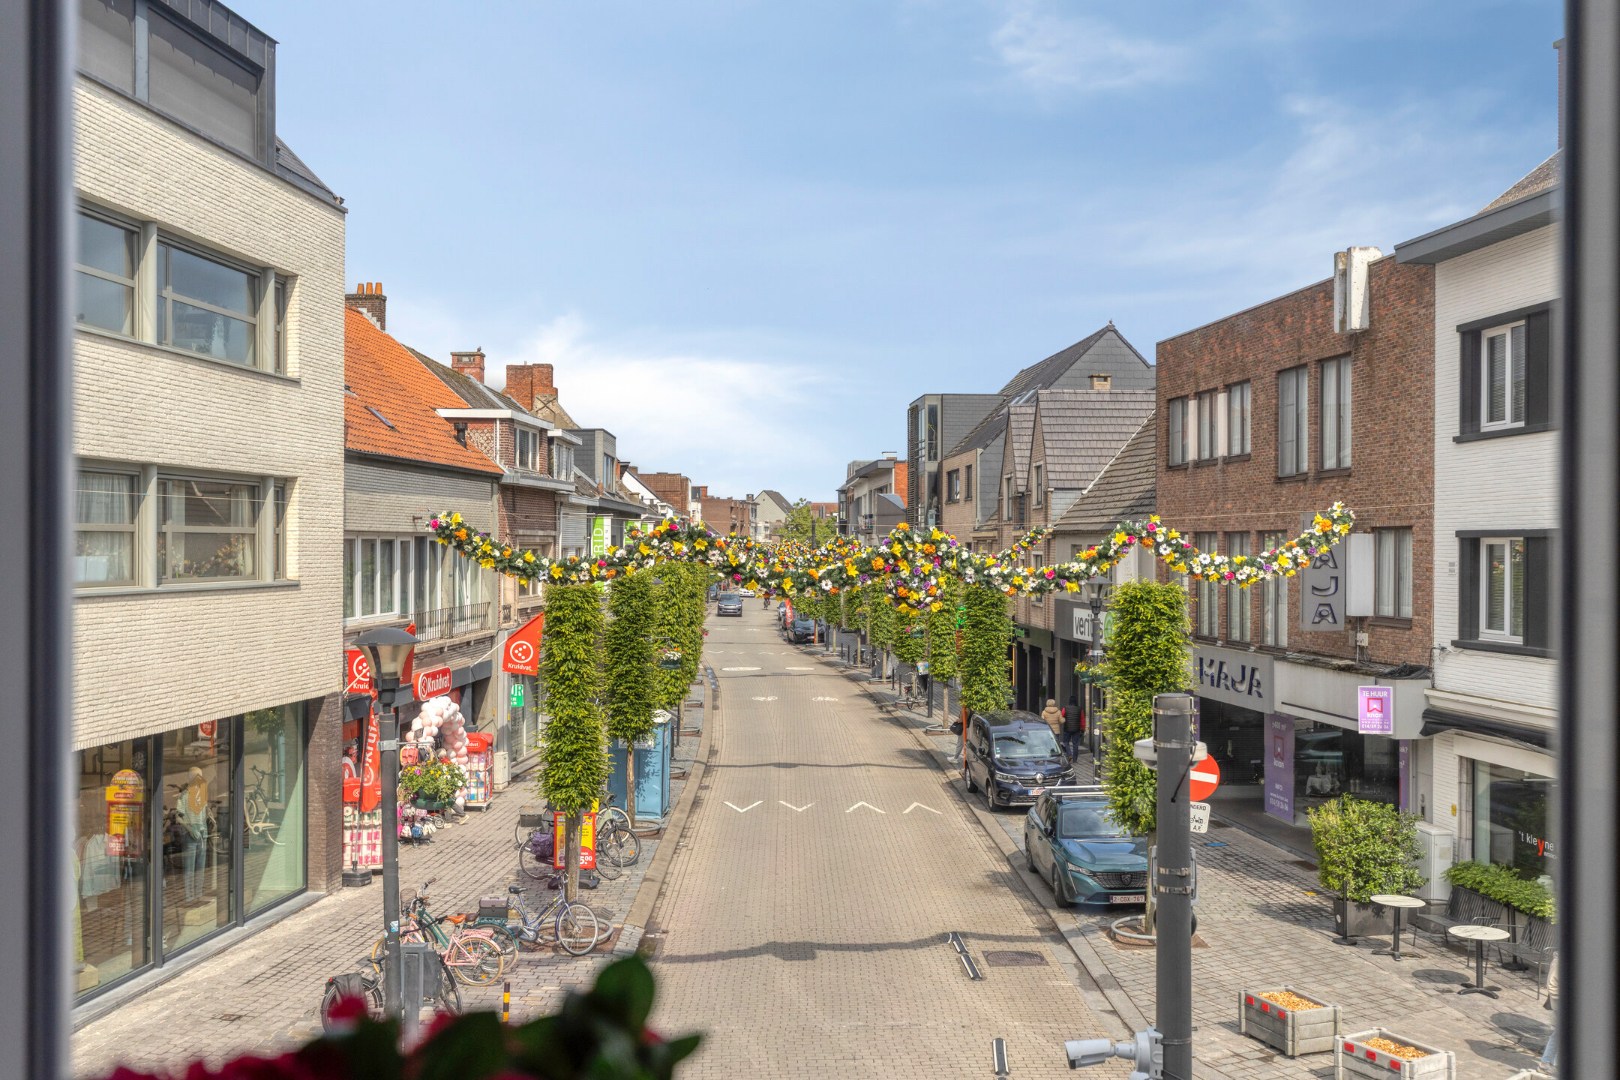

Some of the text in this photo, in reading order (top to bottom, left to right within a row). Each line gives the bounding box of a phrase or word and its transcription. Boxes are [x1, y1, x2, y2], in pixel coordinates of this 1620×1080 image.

[1312, 546, 1338, 624] AJA
[507, 662, 532, 671] Kruidvat
[427, 673, 450, 692] Kruidvat
